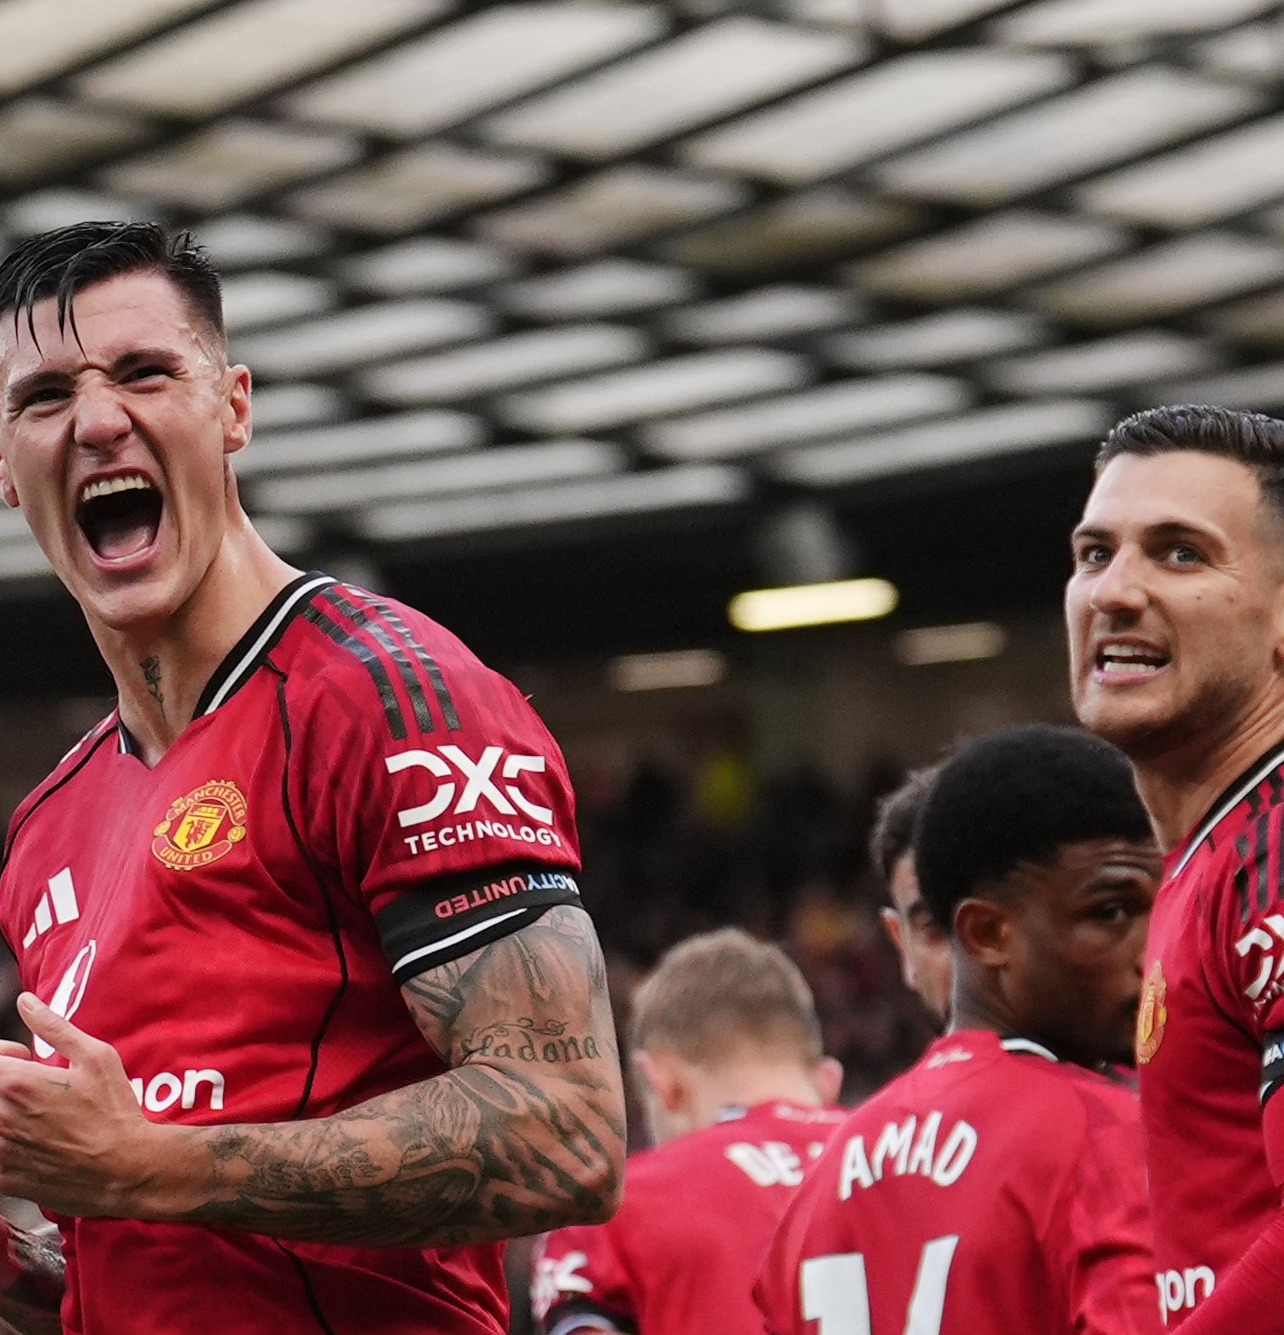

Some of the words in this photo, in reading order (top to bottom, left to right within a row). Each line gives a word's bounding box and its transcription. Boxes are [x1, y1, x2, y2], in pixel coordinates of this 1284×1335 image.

[174, 786, 247, 820] MANCHESTER
[384, 744, 553, 828] DXC
[404, 820, 562, 855] TECHNOLOGY
[159, 846, 214, 865] UNITED
[839, 1111, 978, 1202] AMAD
